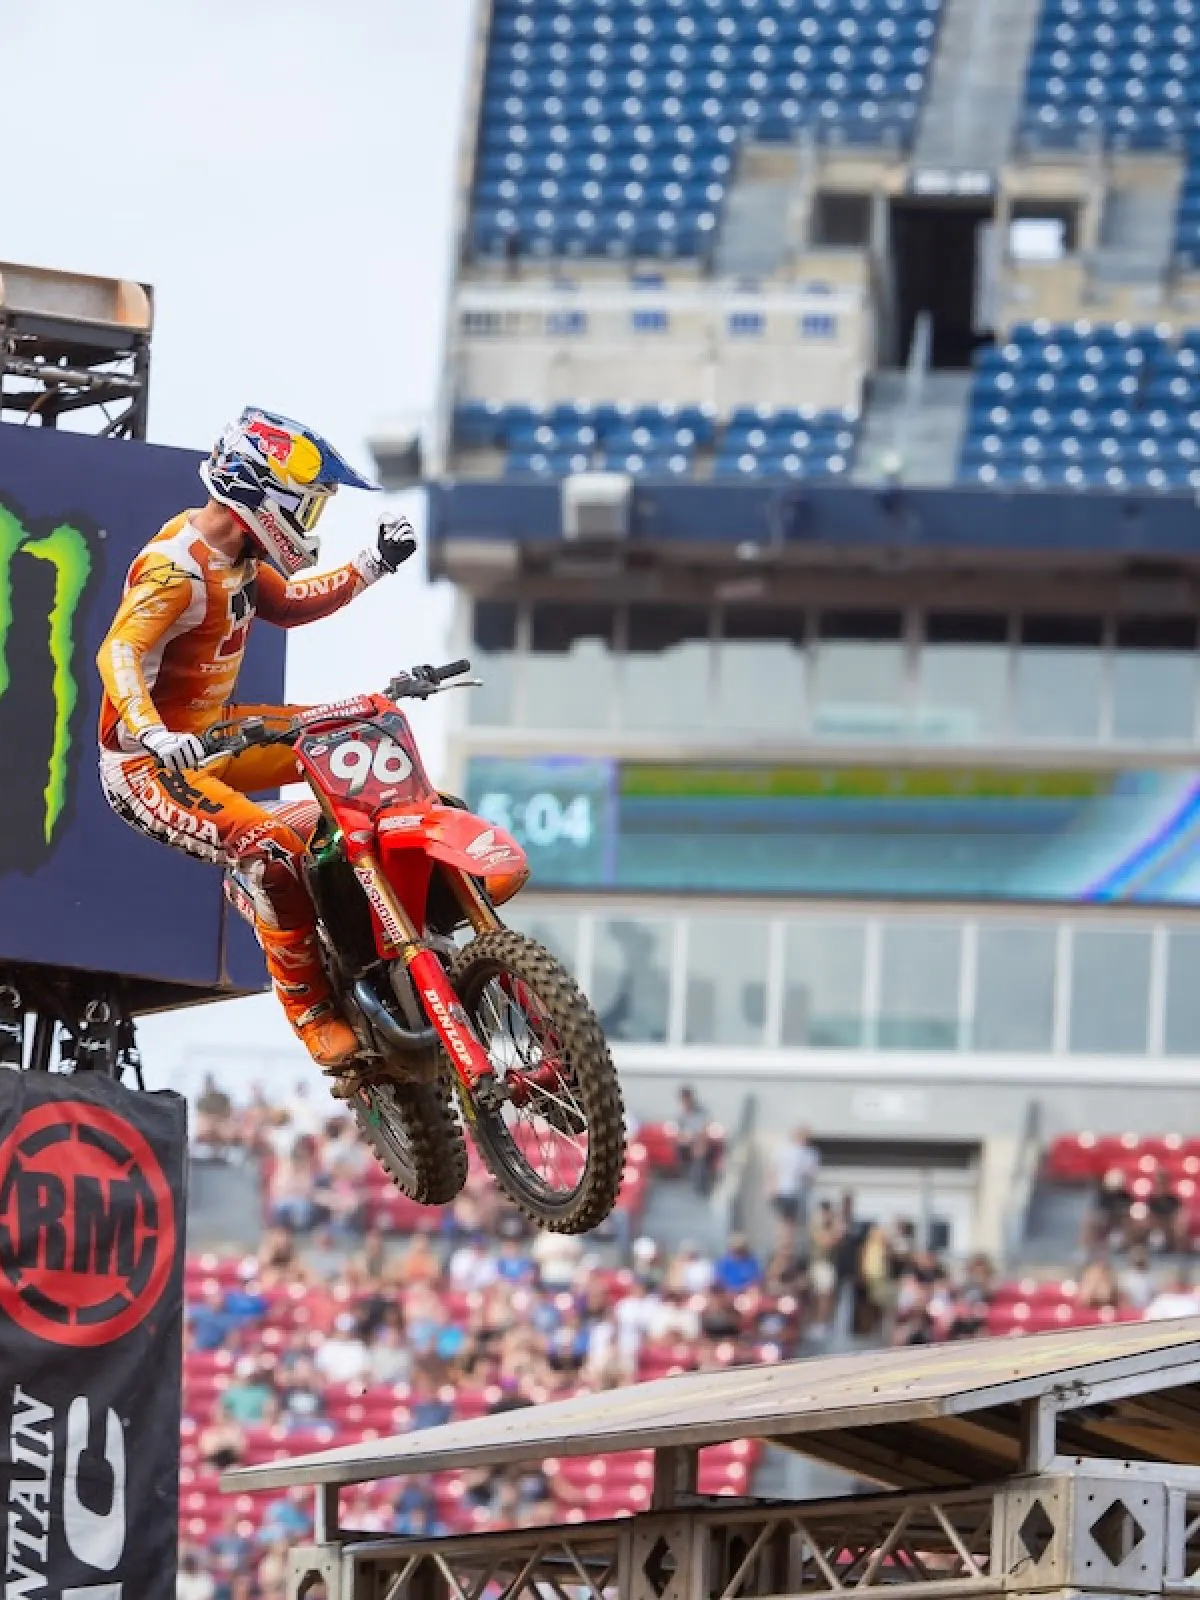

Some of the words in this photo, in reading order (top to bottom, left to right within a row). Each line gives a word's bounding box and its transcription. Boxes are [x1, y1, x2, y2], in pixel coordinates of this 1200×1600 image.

[126, 764, 219, 846] HONDA
[329, 737, 413, 797] 96
[424, 989, 473, 1066] DUNLOP
[8, 1168, 140, 1281] RM
